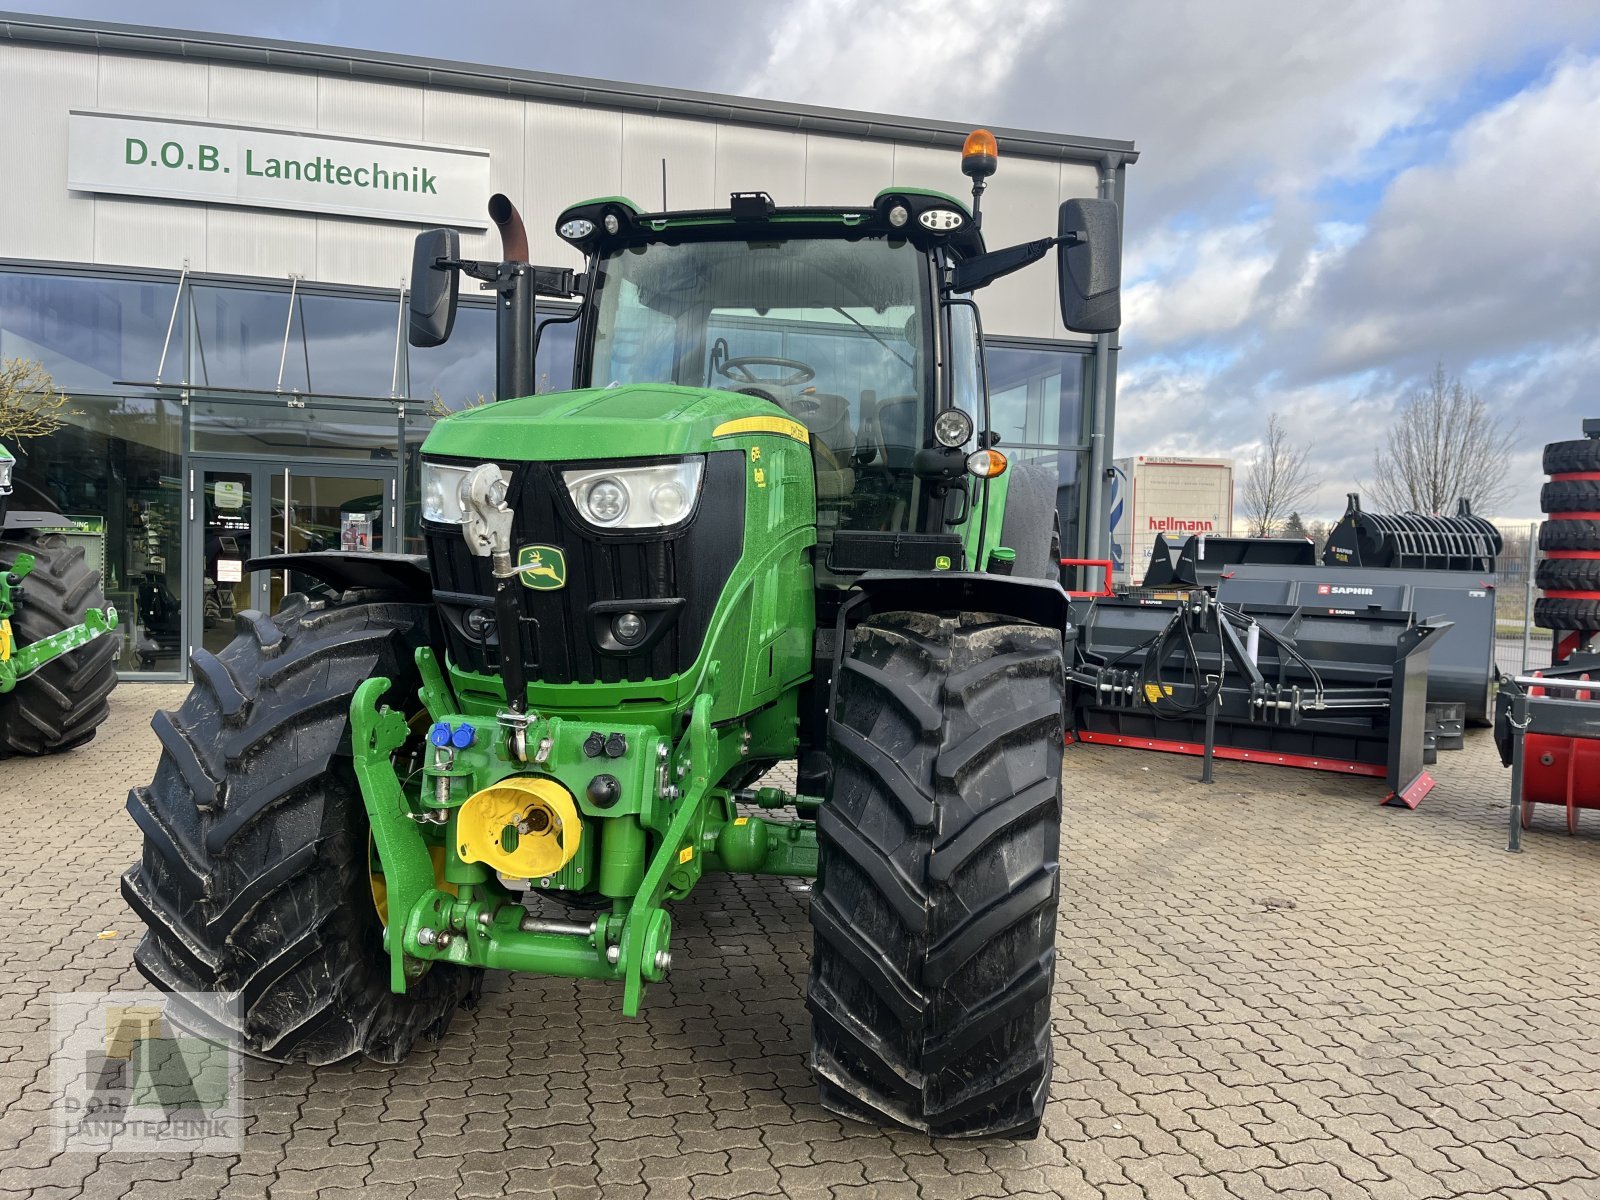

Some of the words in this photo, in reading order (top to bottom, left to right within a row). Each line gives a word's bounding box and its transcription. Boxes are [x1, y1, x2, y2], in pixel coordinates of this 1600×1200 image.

[125, 137, 230, 173] D.O.B.
[246, 149, 437, 195] Landtechnik
[1149, 516, 1212, 531] hellmann
[1331, 586, 1373, 595] SAPHIR
